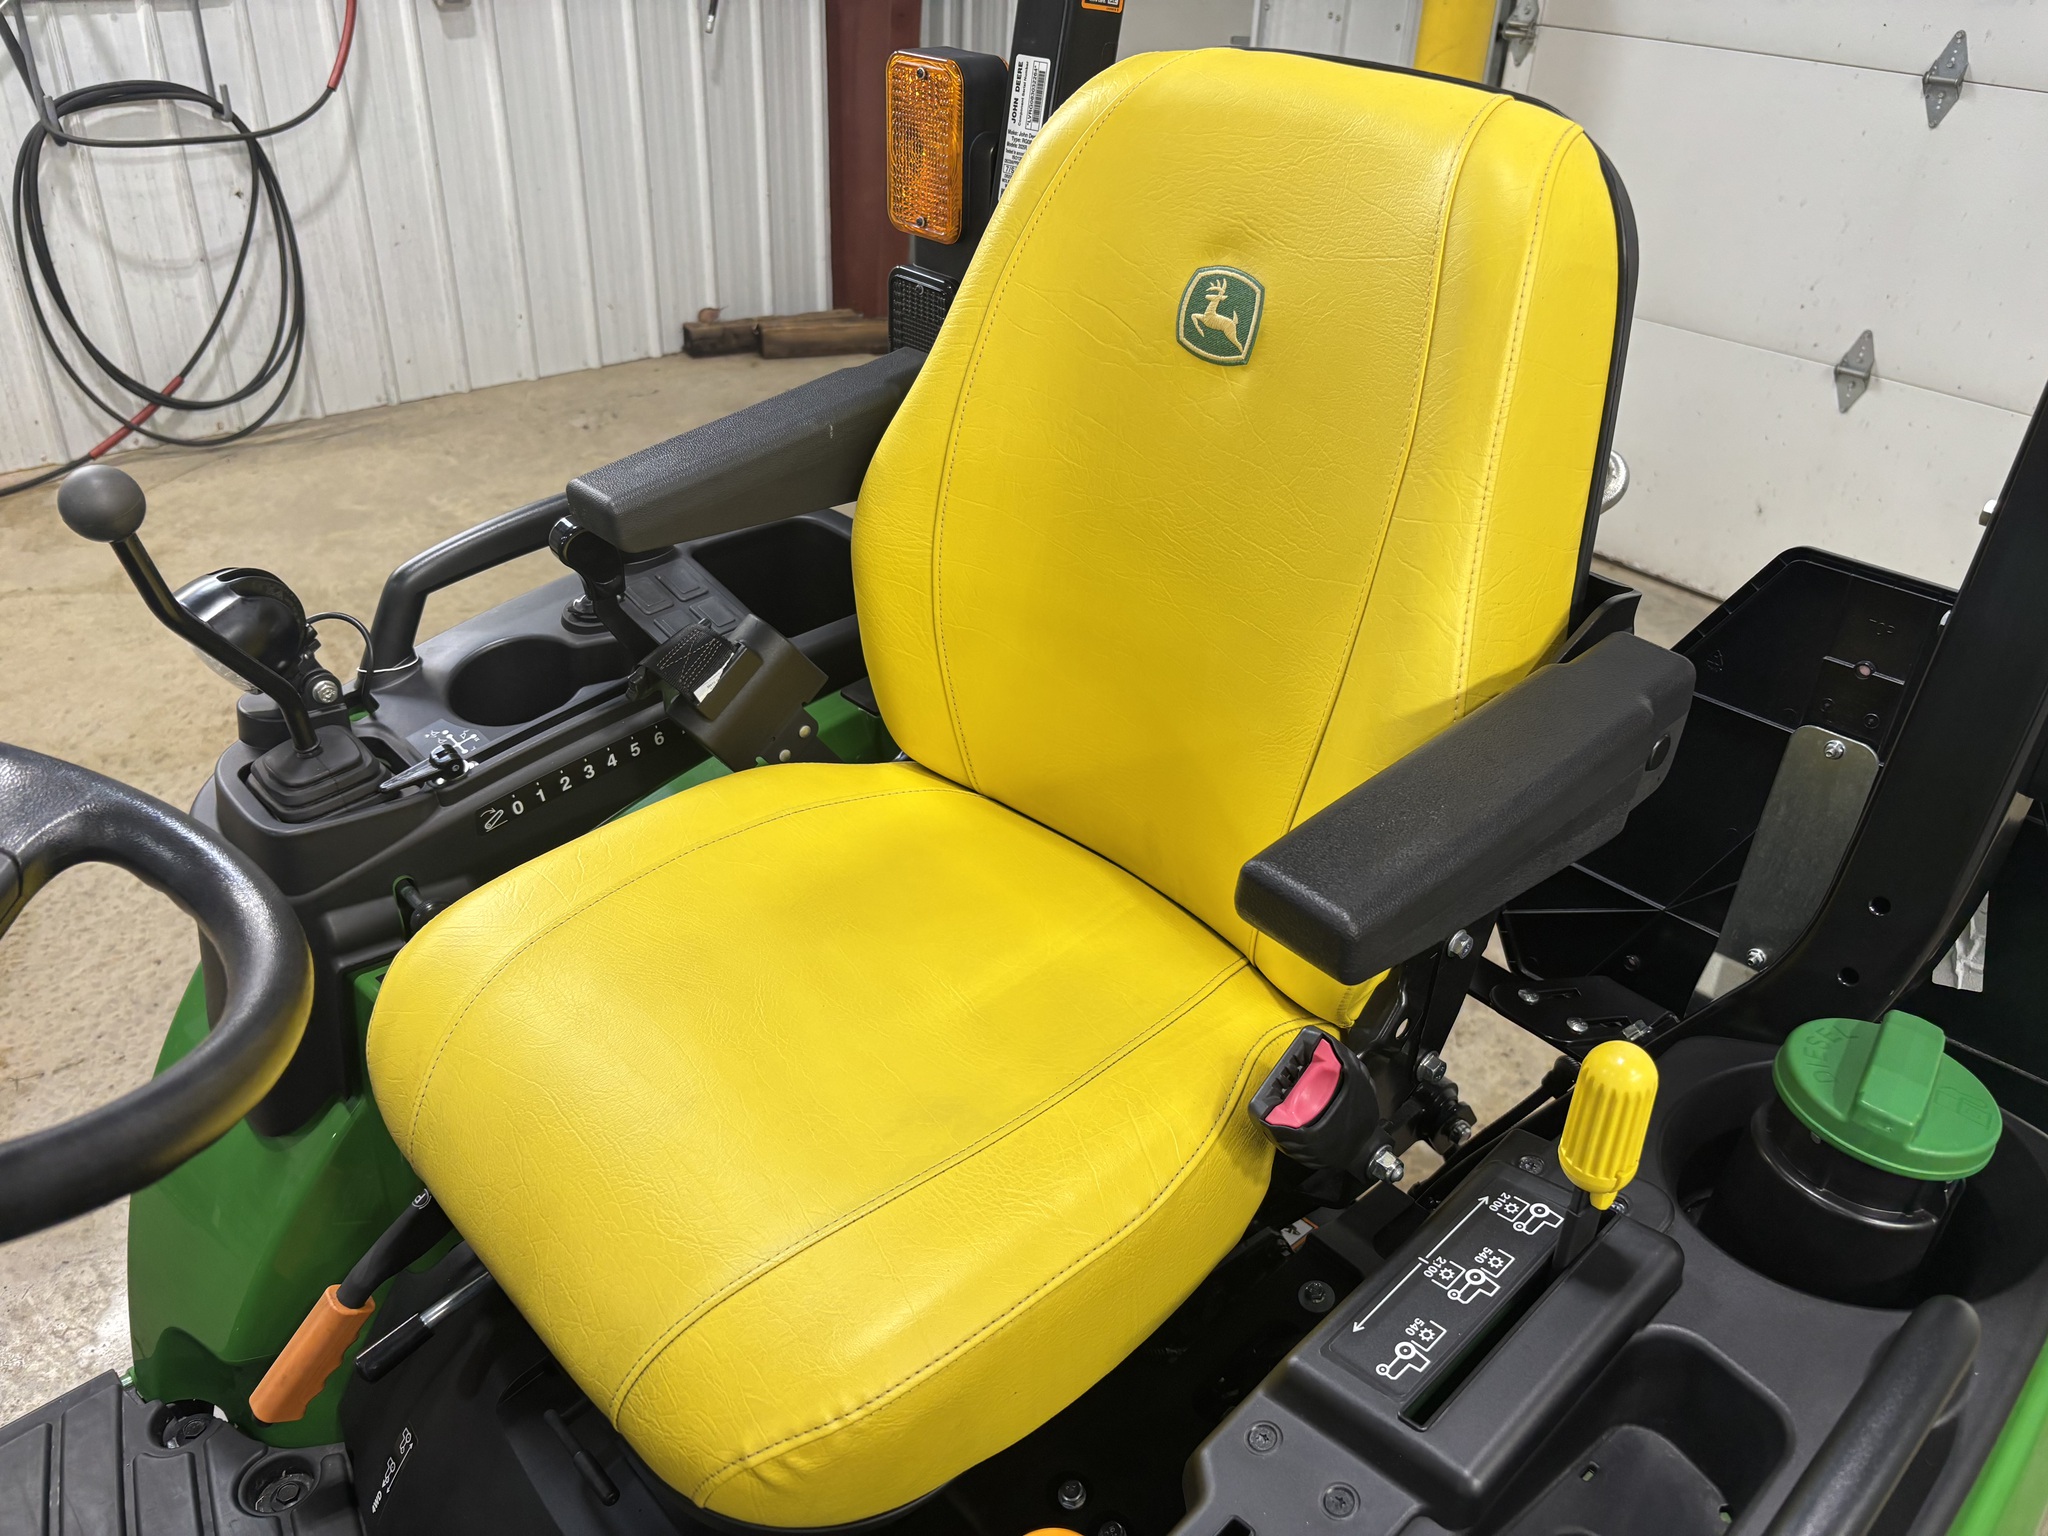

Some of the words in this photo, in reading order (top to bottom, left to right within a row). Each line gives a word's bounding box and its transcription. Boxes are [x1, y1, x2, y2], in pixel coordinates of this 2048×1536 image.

[1011, 98, 1019, 124] JOHN
[1015, 61, 1024, 92] DEERE
[511, 800, 524, 816] 0
[536, 789, 546, 802] 1
[560, 776, 573, 792] 2
[583, 764, 596, 779] 3
[607, 753, 618, 767] 4
[630, 742, 641, 757] 5
[654, 731, 665, 746] 6
[1803, 1024, 1860, 1084] DIESEL
[1489, 1192, 1512, 1212] 2100
[1473, 1246, 1494, 1264] 540
[1424, 1256, 1447, 1278] 2100
[1405, 1317, 1425, 1336] 540
[372, 1490, 382, 1514] 4WD
